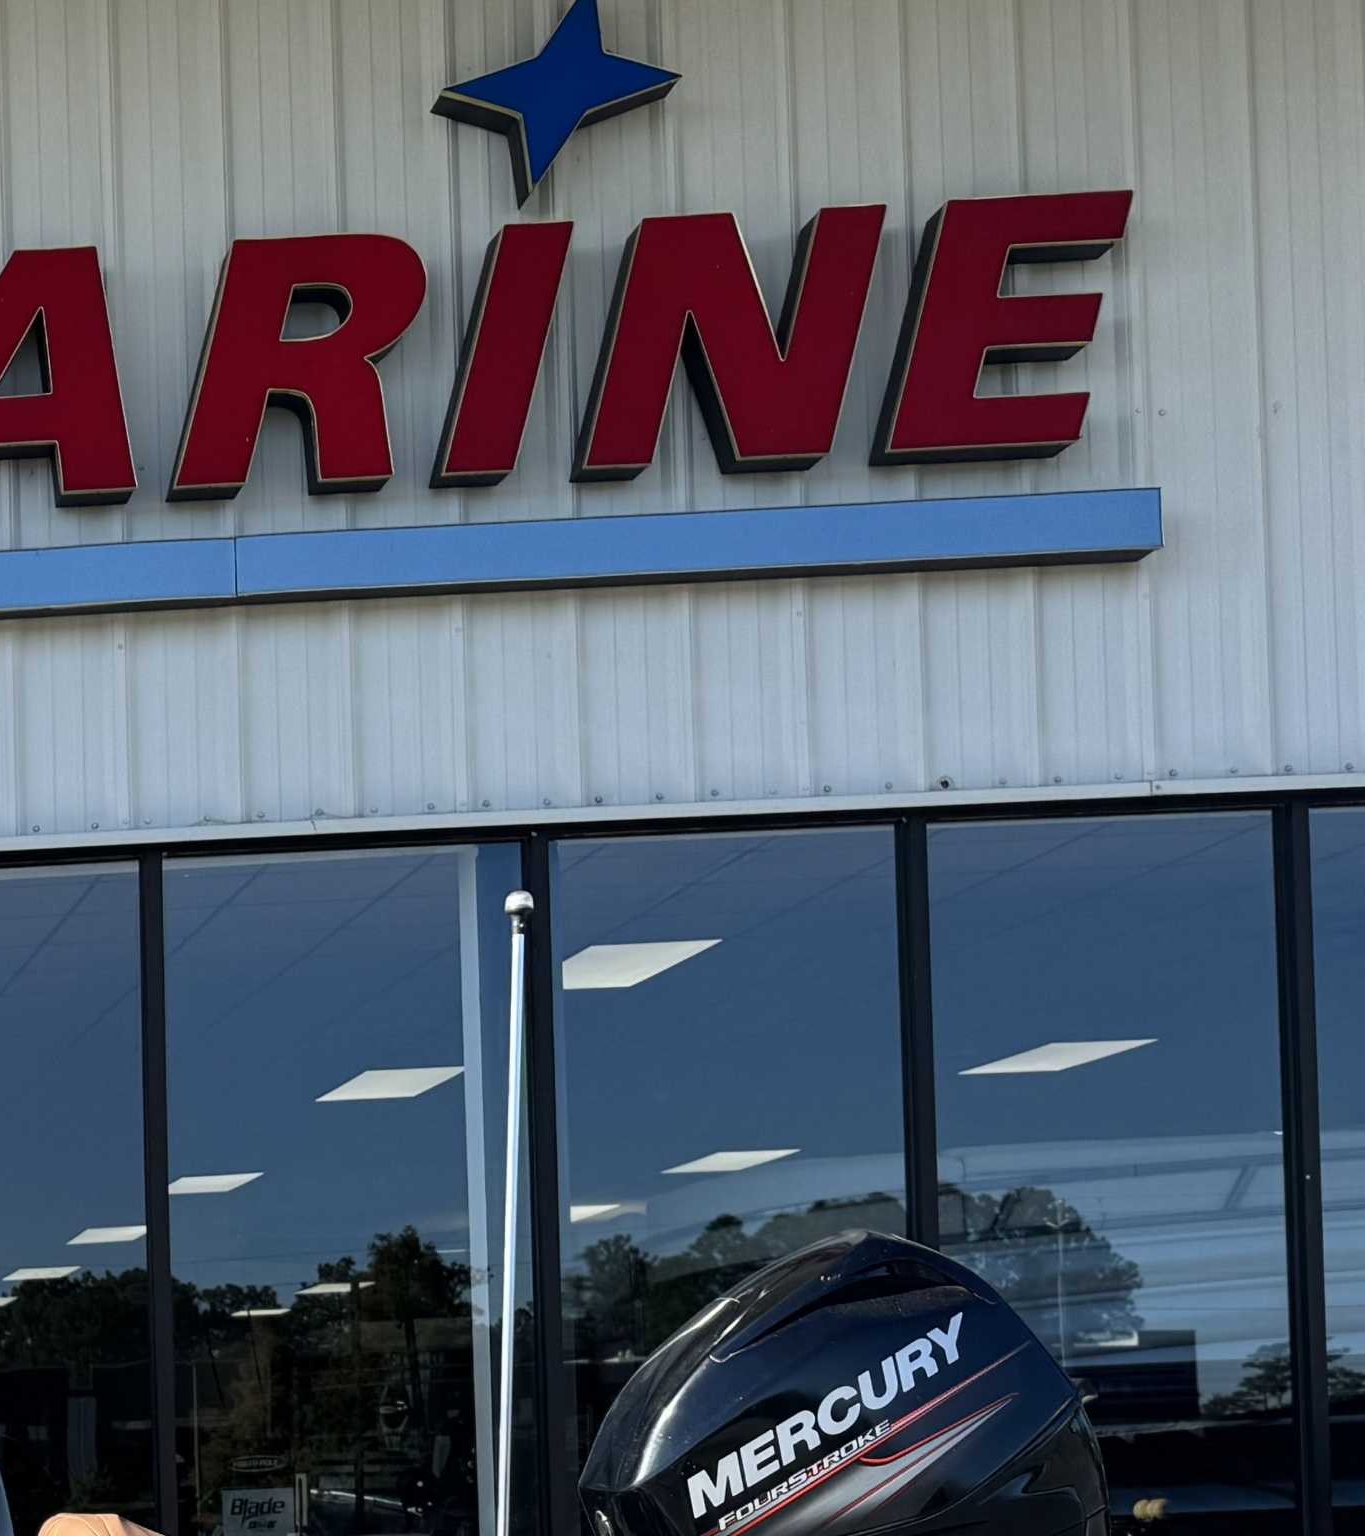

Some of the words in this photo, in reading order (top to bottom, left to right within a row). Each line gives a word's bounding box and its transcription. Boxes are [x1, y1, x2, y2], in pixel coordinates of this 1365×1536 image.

[687, 1312, 963, 1518] MERCURY
[230, 1498, 285, 1522] Blade
[718, 1419, 893, 1531] FOURSTROKE
